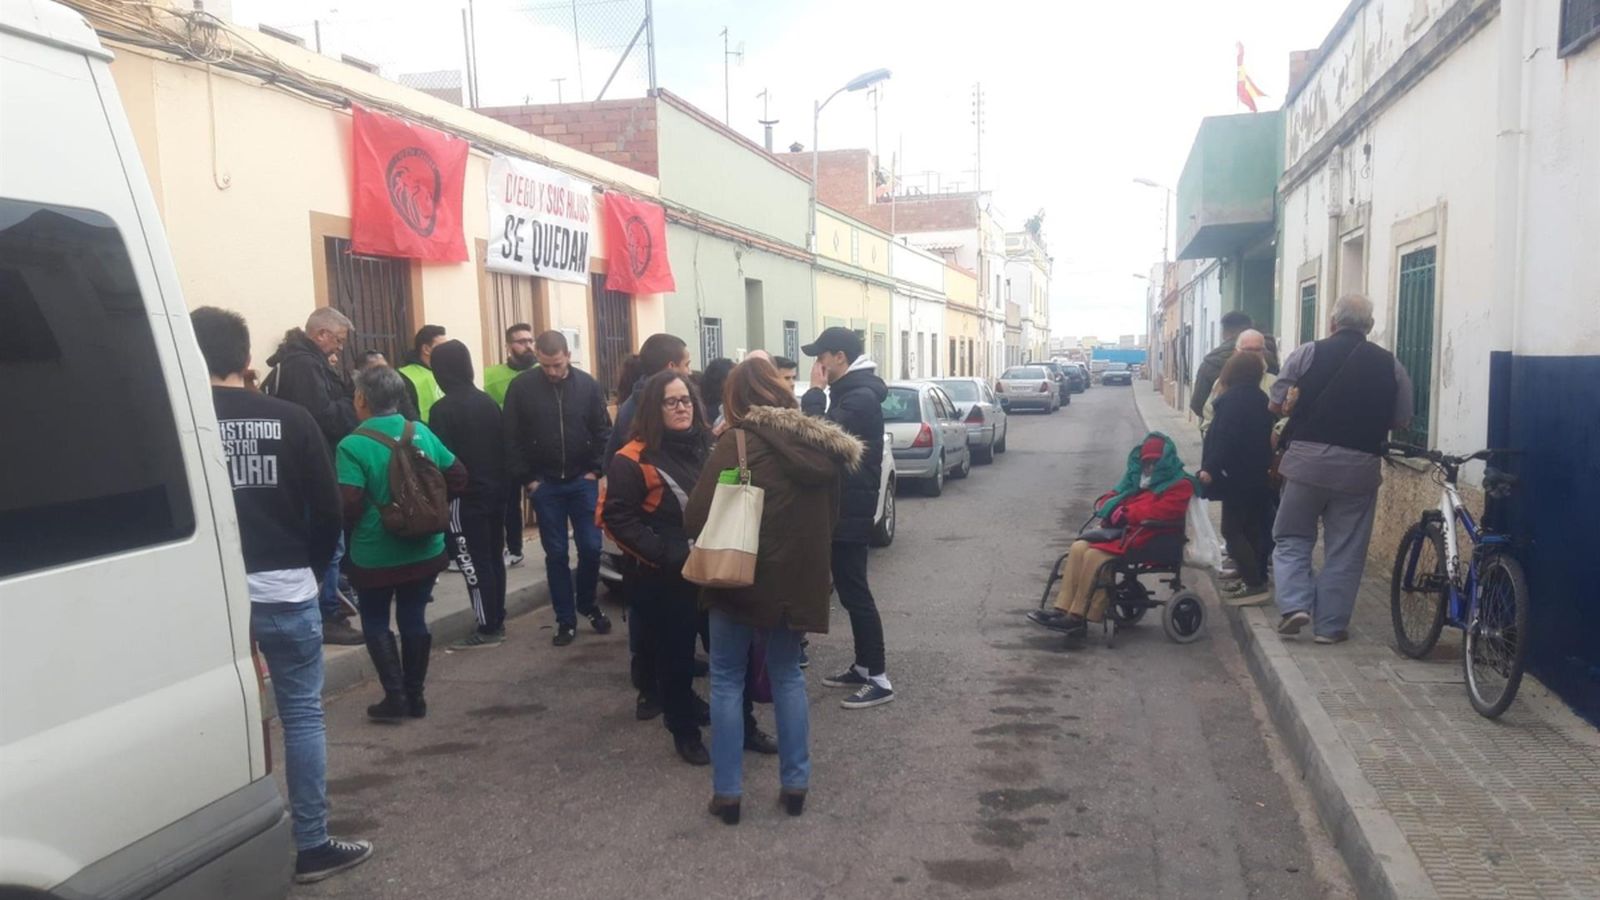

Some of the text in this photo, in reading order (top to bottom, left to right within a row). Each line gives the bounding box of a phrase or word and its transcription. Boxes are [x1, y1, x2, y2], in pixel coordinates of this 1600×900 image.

[505, 173, 536, 209] DIEGO
[539, 182, 545, 212] Y
[546, 183, 565, 217] SUS
[501, 214, 588, 273] SE QUEDAN
[226, 455, 278, 485] URO
[456, 536, 478, 585] adidas
